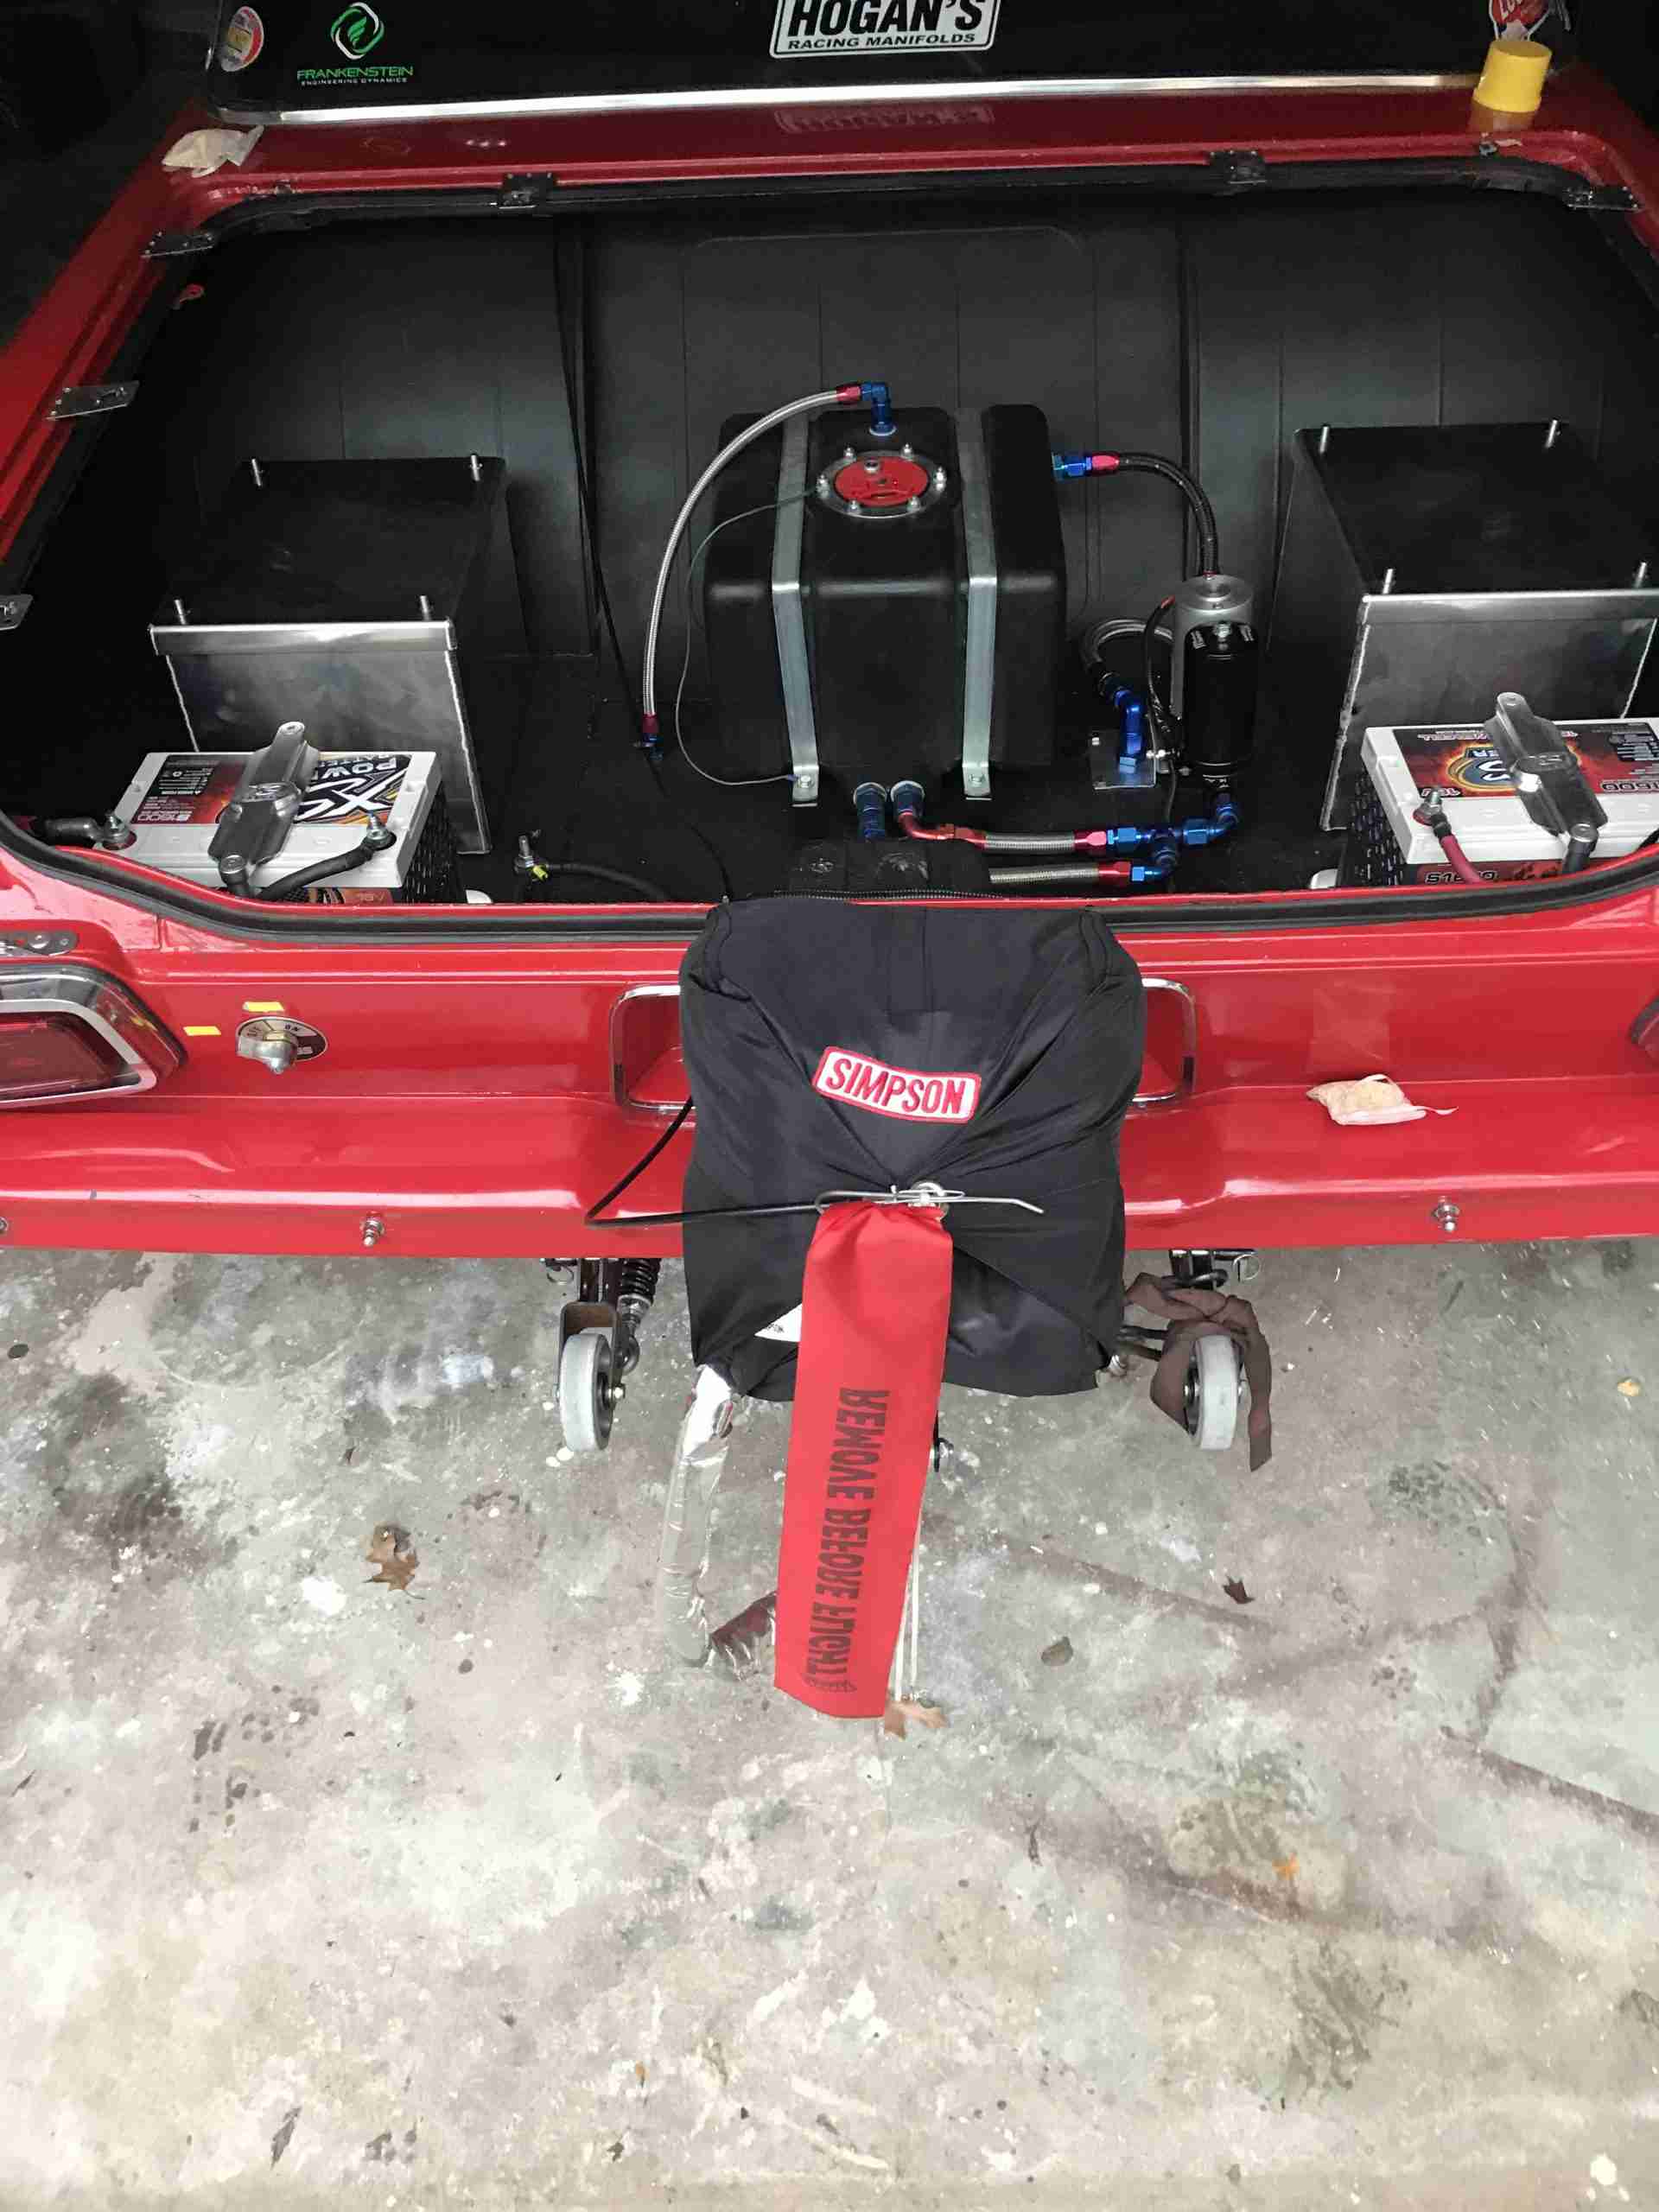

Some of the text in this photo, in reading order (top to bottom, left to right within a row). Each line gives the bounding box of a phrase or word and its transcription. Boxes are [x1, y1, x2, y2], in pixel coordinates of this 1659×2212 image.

[787, 0, 983, 36] HOGAN'S
[788, 34, 976, 49] RACING MANIFOLDS
[296, 66, 414, 79] FRANKENSTEIN
[826, 1058, 966, 1115] SIMPSON
